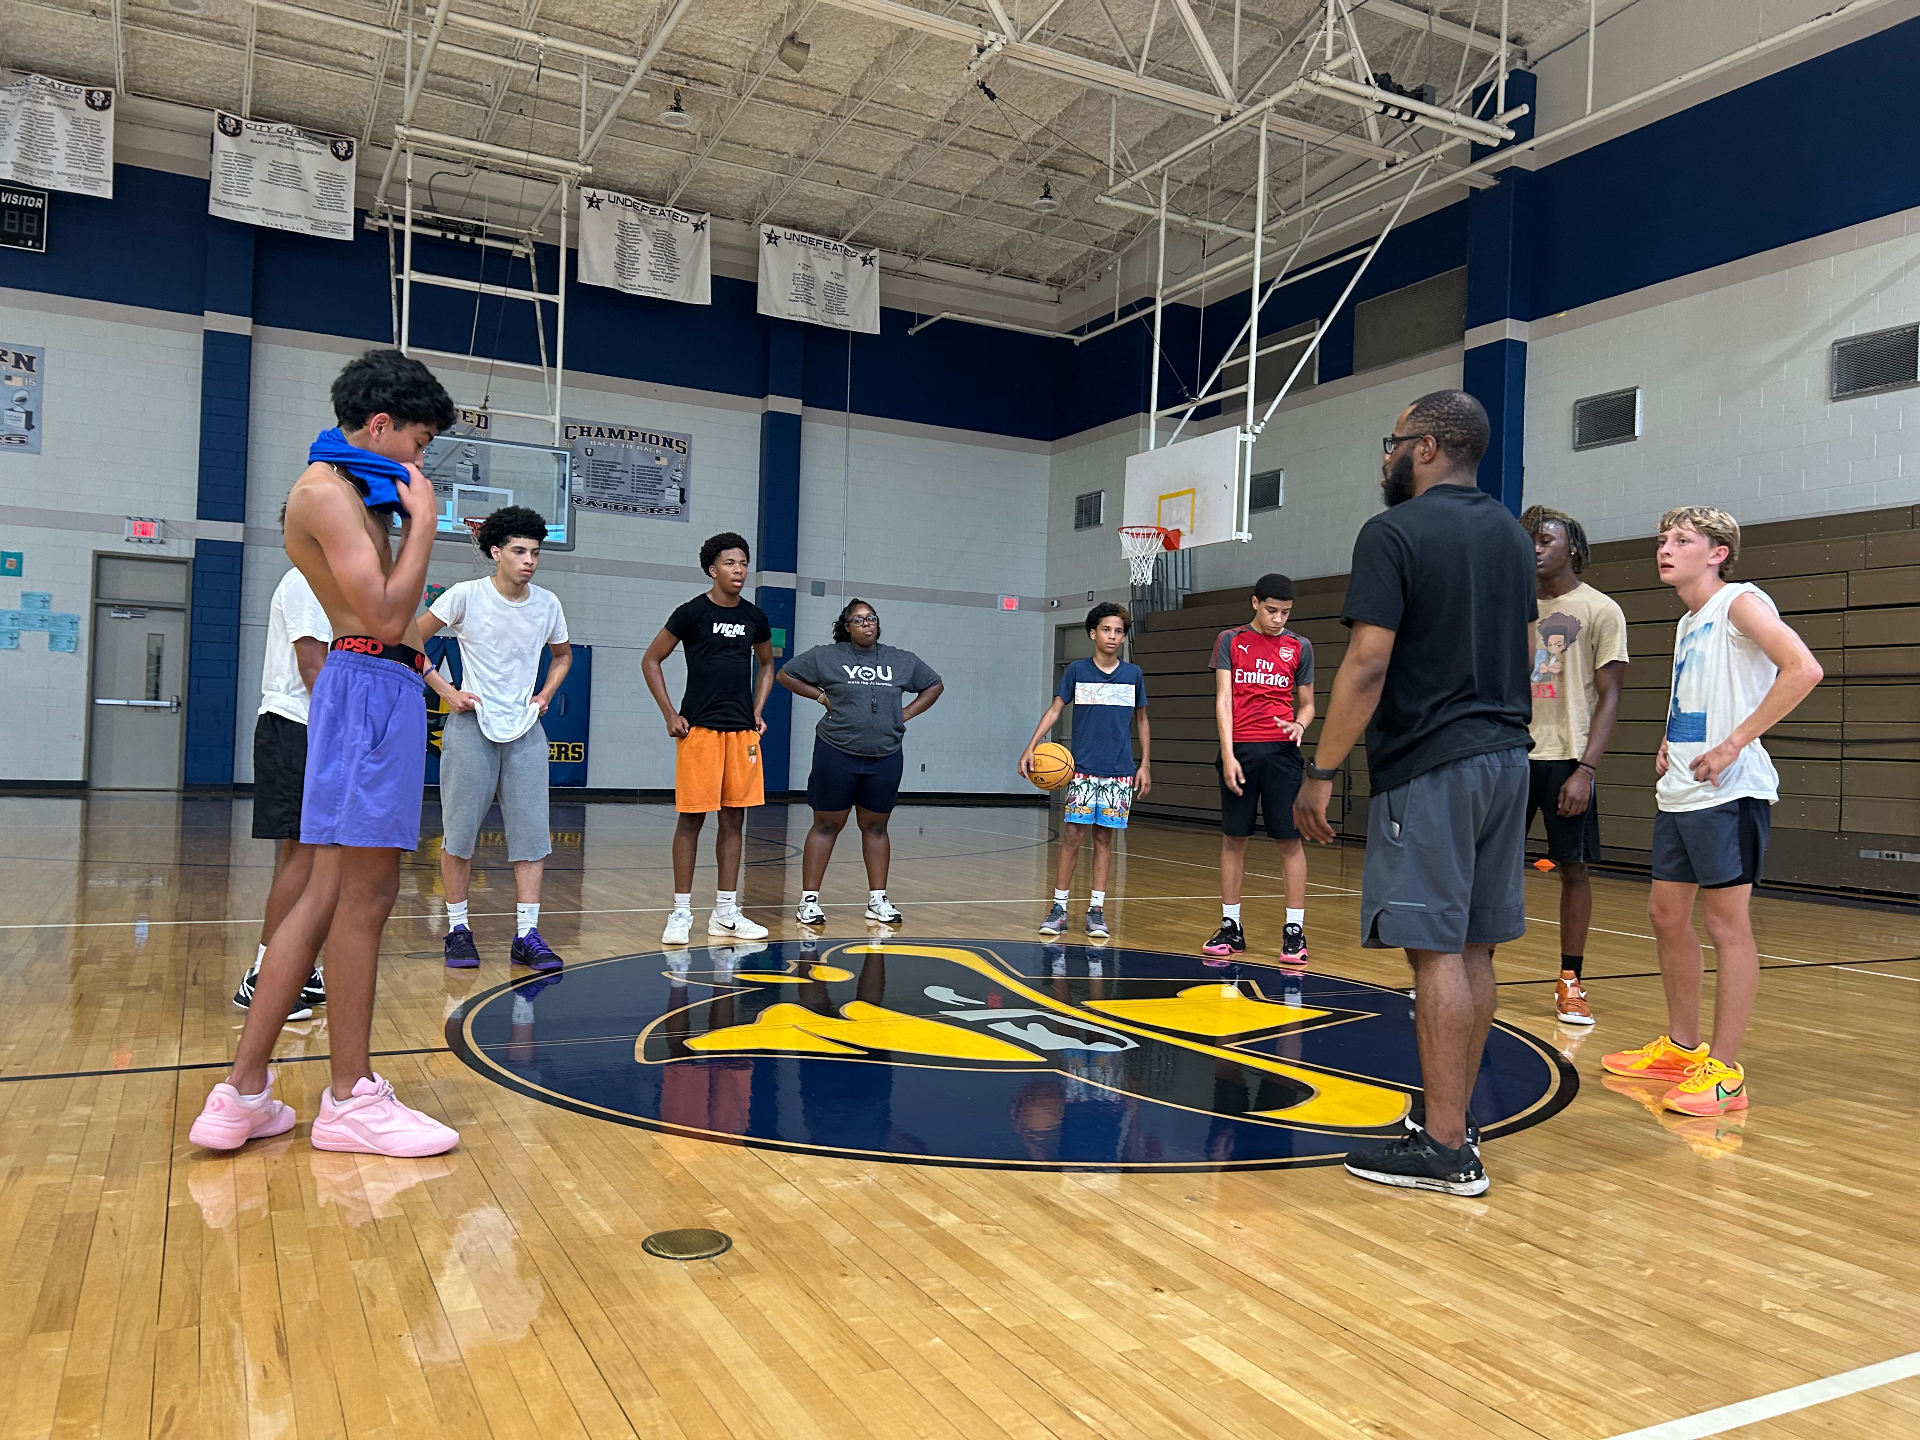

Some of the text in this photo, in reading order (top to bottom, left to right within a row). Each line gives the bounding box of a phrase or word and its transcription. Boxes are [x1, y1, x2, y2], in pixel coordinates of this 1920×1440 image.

[244, 122, 273, 133] CITY
[1, 192, 43, 208] VISITOR
[607, 193, 690, 224] UNDEFEATED
[784, 231, 859, 258] UNDEFEATED
[456, 409, 489, 431] ED
[564, 425, 688, 455] CHAMPIONS
[589, 440, 617, 448] BACK
[636, 445, 662, 455] BACK
[571, 494, 682, 516] RAIDERS
[133, 521, 156, 538] EXIT
[342, 637, 384, 655] PSD
[841, 665, 893, 681] YOU
[1255, 658, 1275, 673] Fly
[1234, 668, 1290, 688] Emirates
